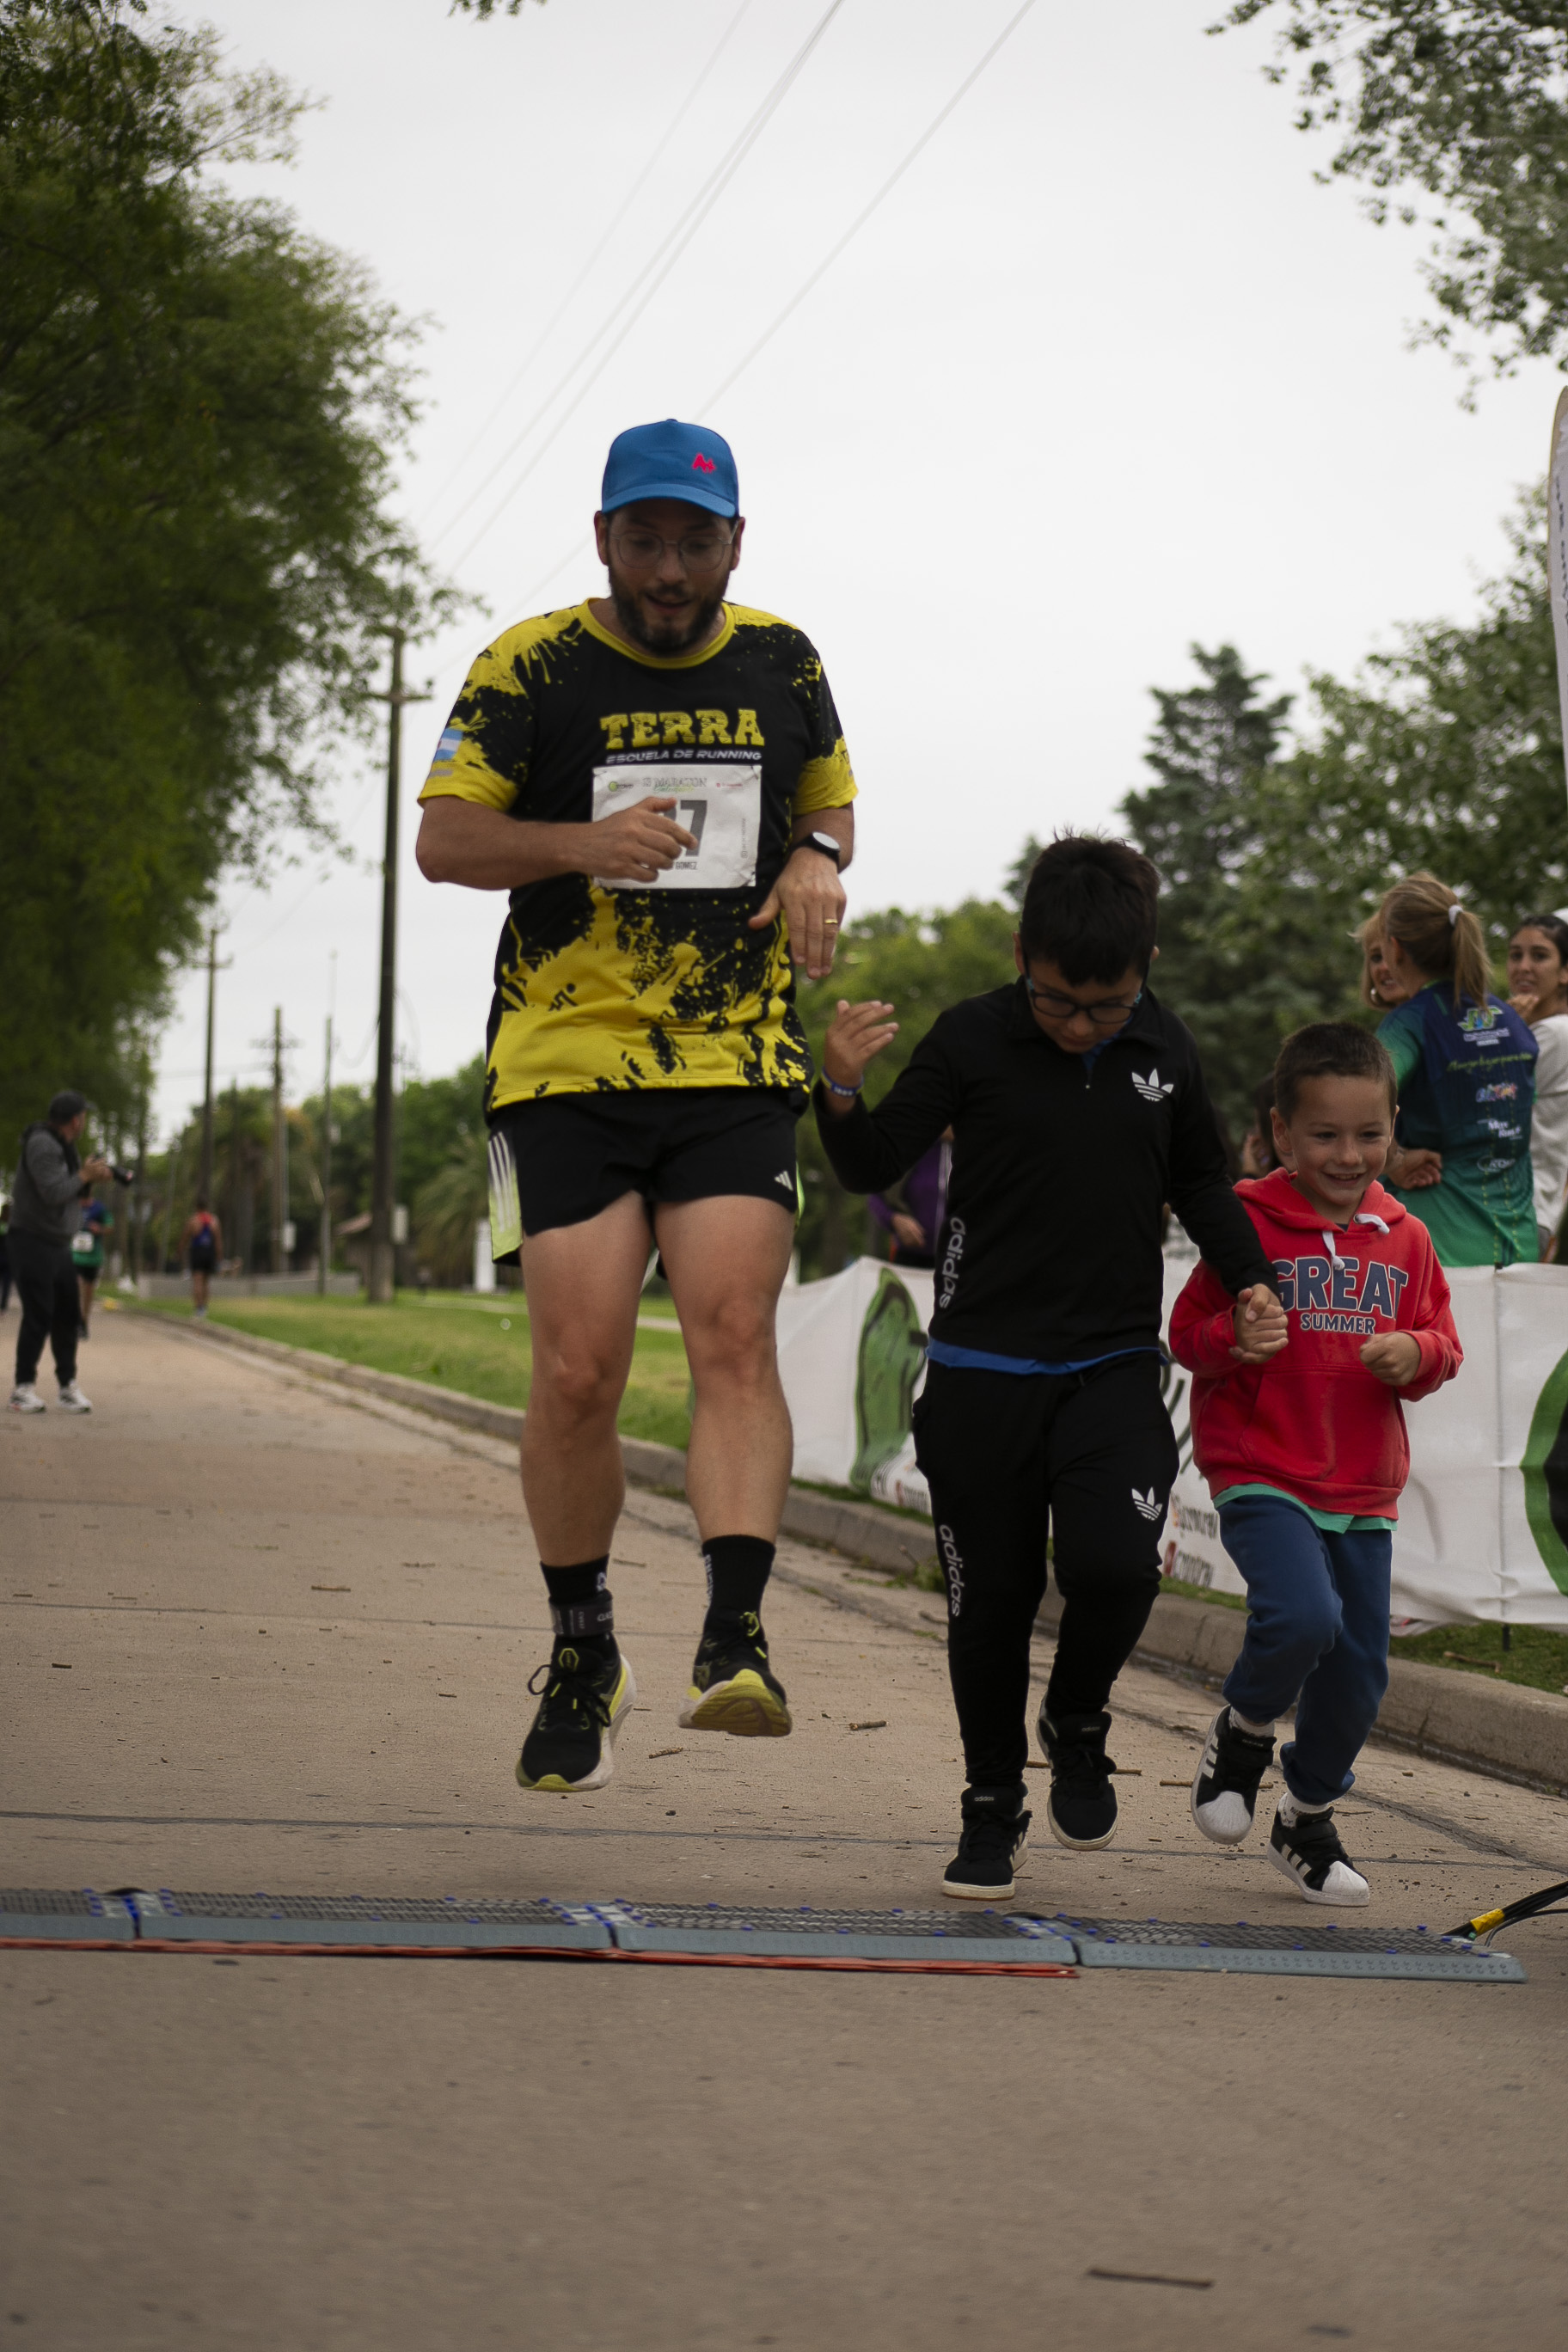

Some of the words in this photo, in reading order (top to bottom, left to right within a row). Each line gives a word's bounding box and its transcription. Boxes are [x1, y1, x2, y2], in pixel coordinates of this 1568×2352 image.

[599, 708, 765, 750] TERRA
[605, 750, 670, 764] ESCUELA
[672, 750, 695, 759] DE
[696, 750, 763, 761] RUNNING
[939, 1217, 966, 1308] adidas
[1271, 1256, 1409, 1320] GREAT
[1300, 1313, 1375, 1335] SUMMER
[939, 1524, 965, 1617] adidas
